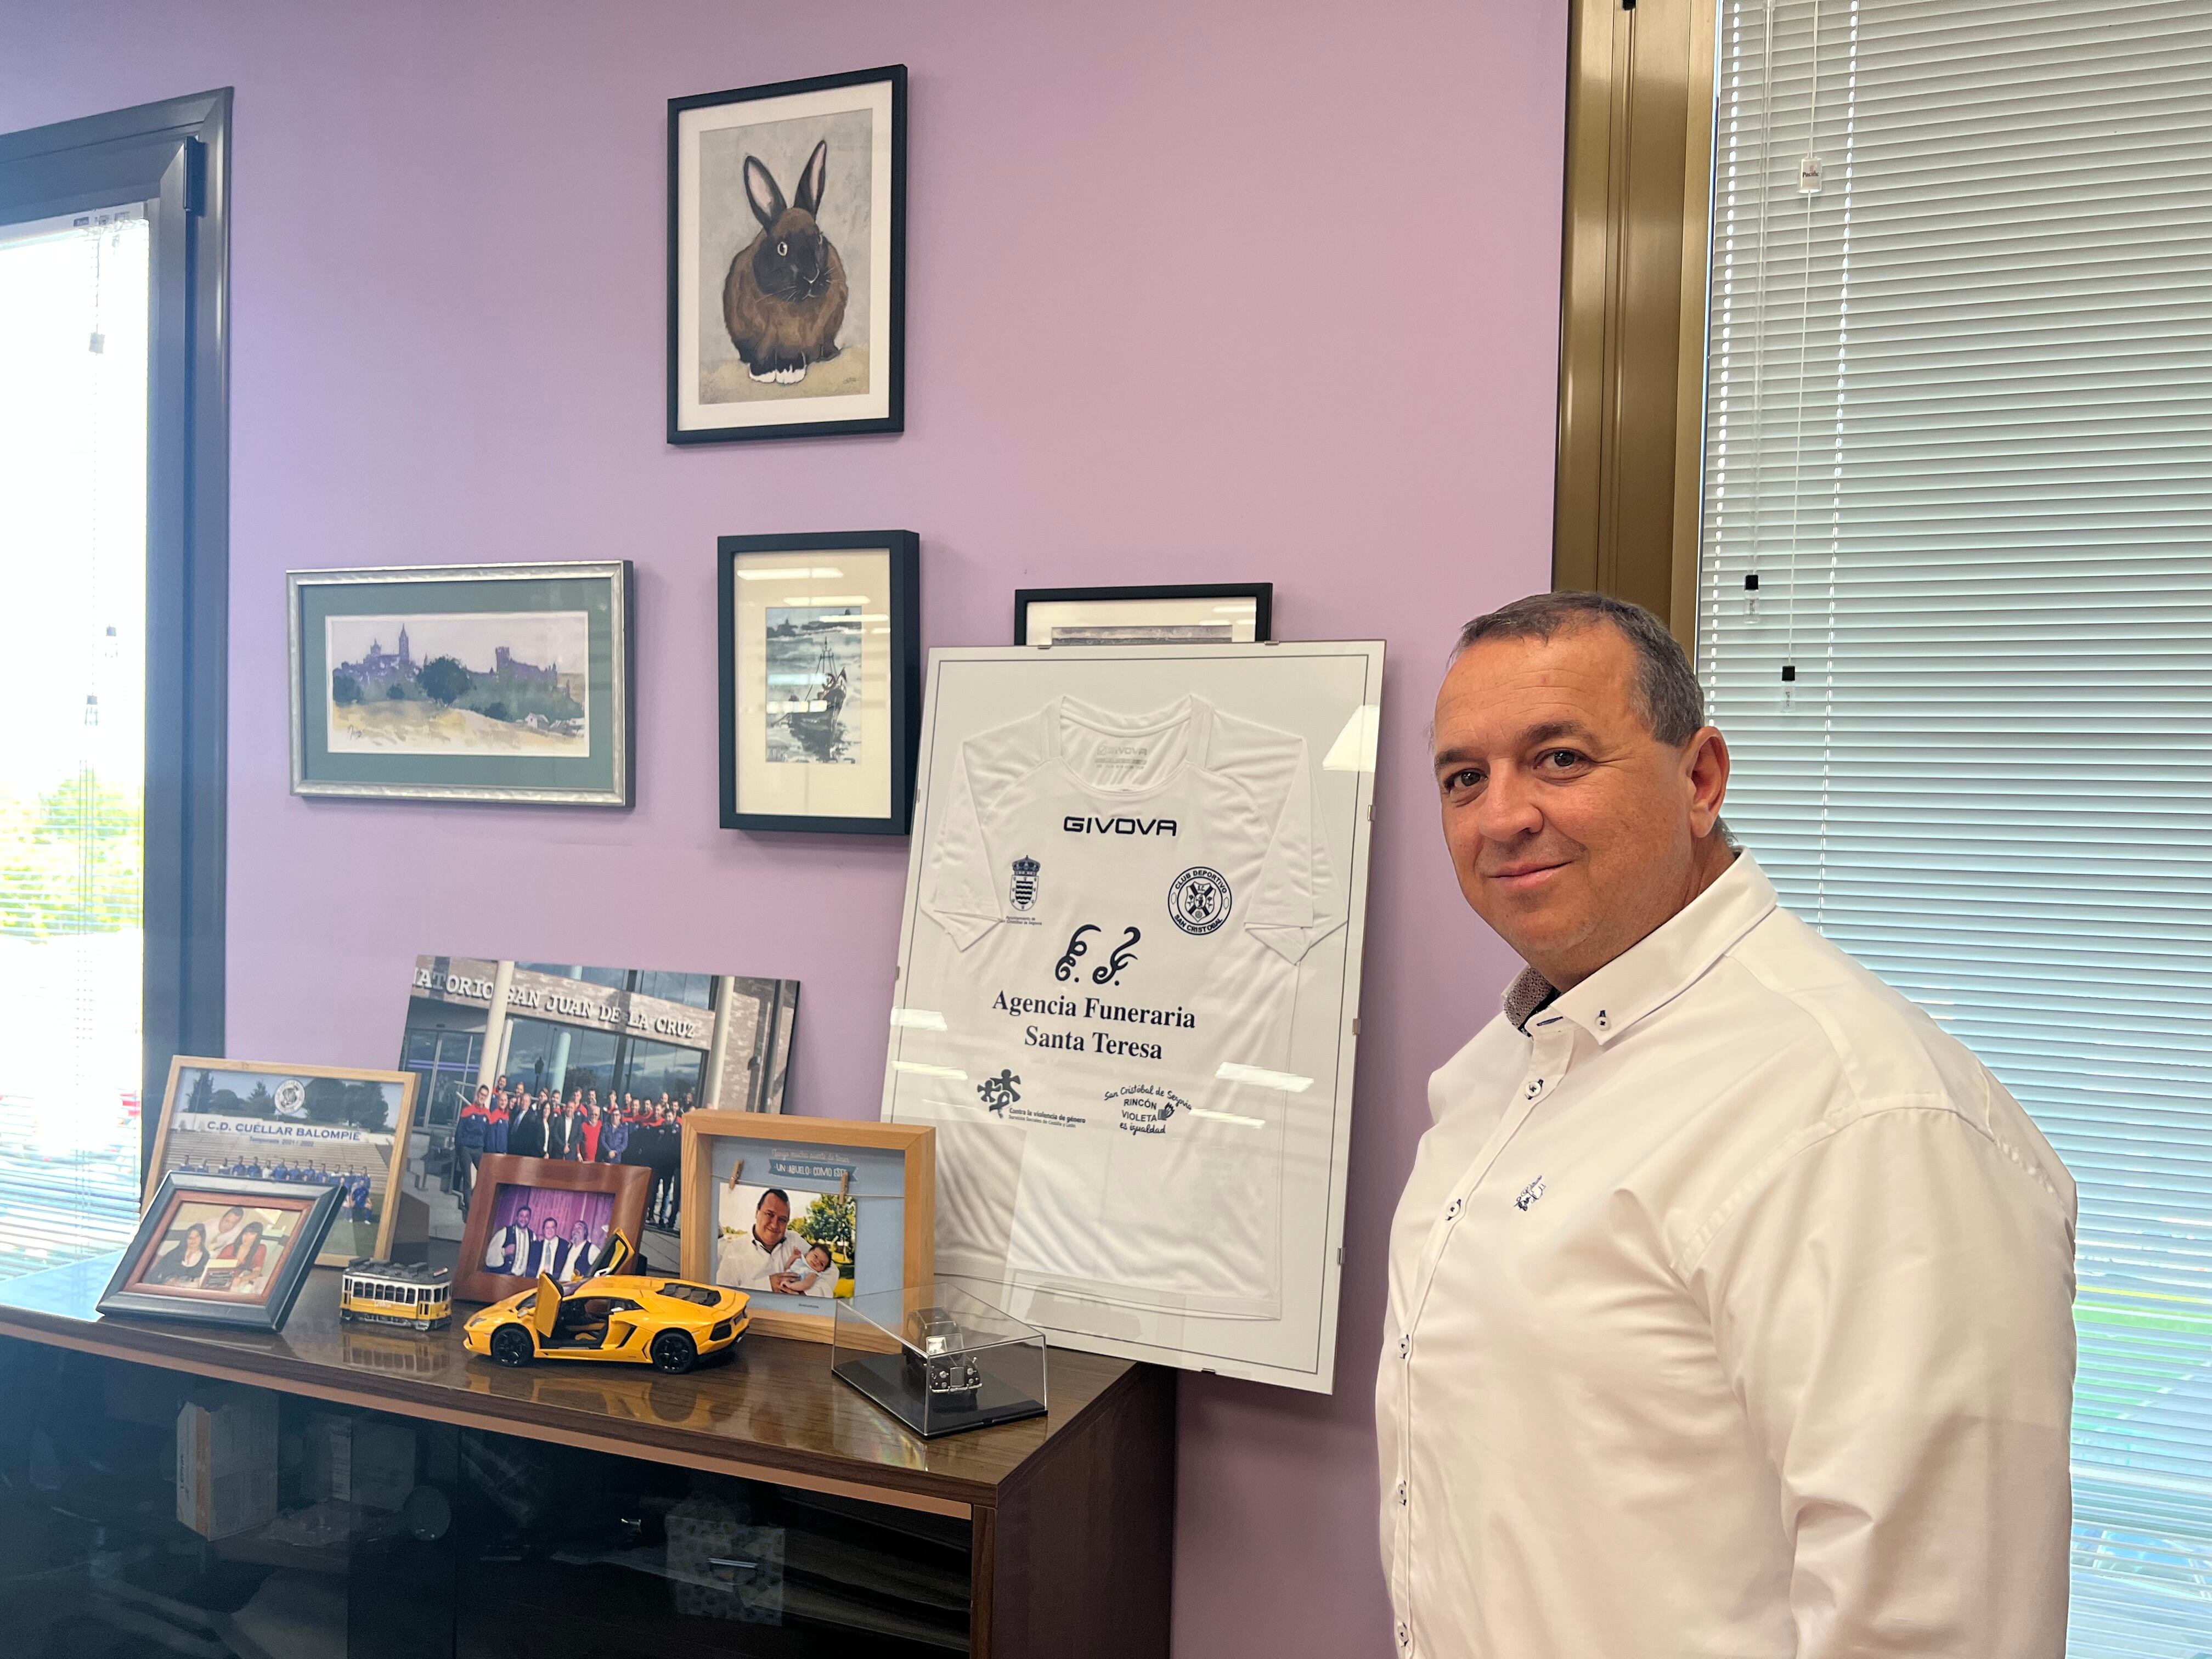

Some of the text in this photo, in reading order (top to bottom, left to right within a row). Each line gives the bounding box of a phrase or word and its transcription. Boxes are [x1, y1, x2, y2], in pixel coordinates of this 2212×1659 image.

[1063, 816, 1177, 837] GIVOVA
[1175, 870, 1227, 894] CLUB DEPORTIVO
[1174, 914, 1223, 933] SAN CRISTOBAL
[545, 995, 594, 1018] JUAN
[599, 1003, 622, 1024] DE
[627, 1007, 650, 1030] LA
[655, 1015, 695, 1038] CRUZ
[992, 990, 1196, 1029] Agencia Funeraria
[1024, 1025, 1163, 1060] Santa Teresa
[1155, 1086, 1165, 1097] de
[1123, 1098, 1158, 1110] RINCÓN
[1121, 1109, 1158, 1122] VIOLETA
[207, 1121, 232, 1131] C.D.
[1119, 1122, 1166, 1135] es igualdad
[776, 1163, 786, 1172] UN
[788, 1164, 810, 1175] ABUELO
[812, 1166, 832, 1177] COMO
